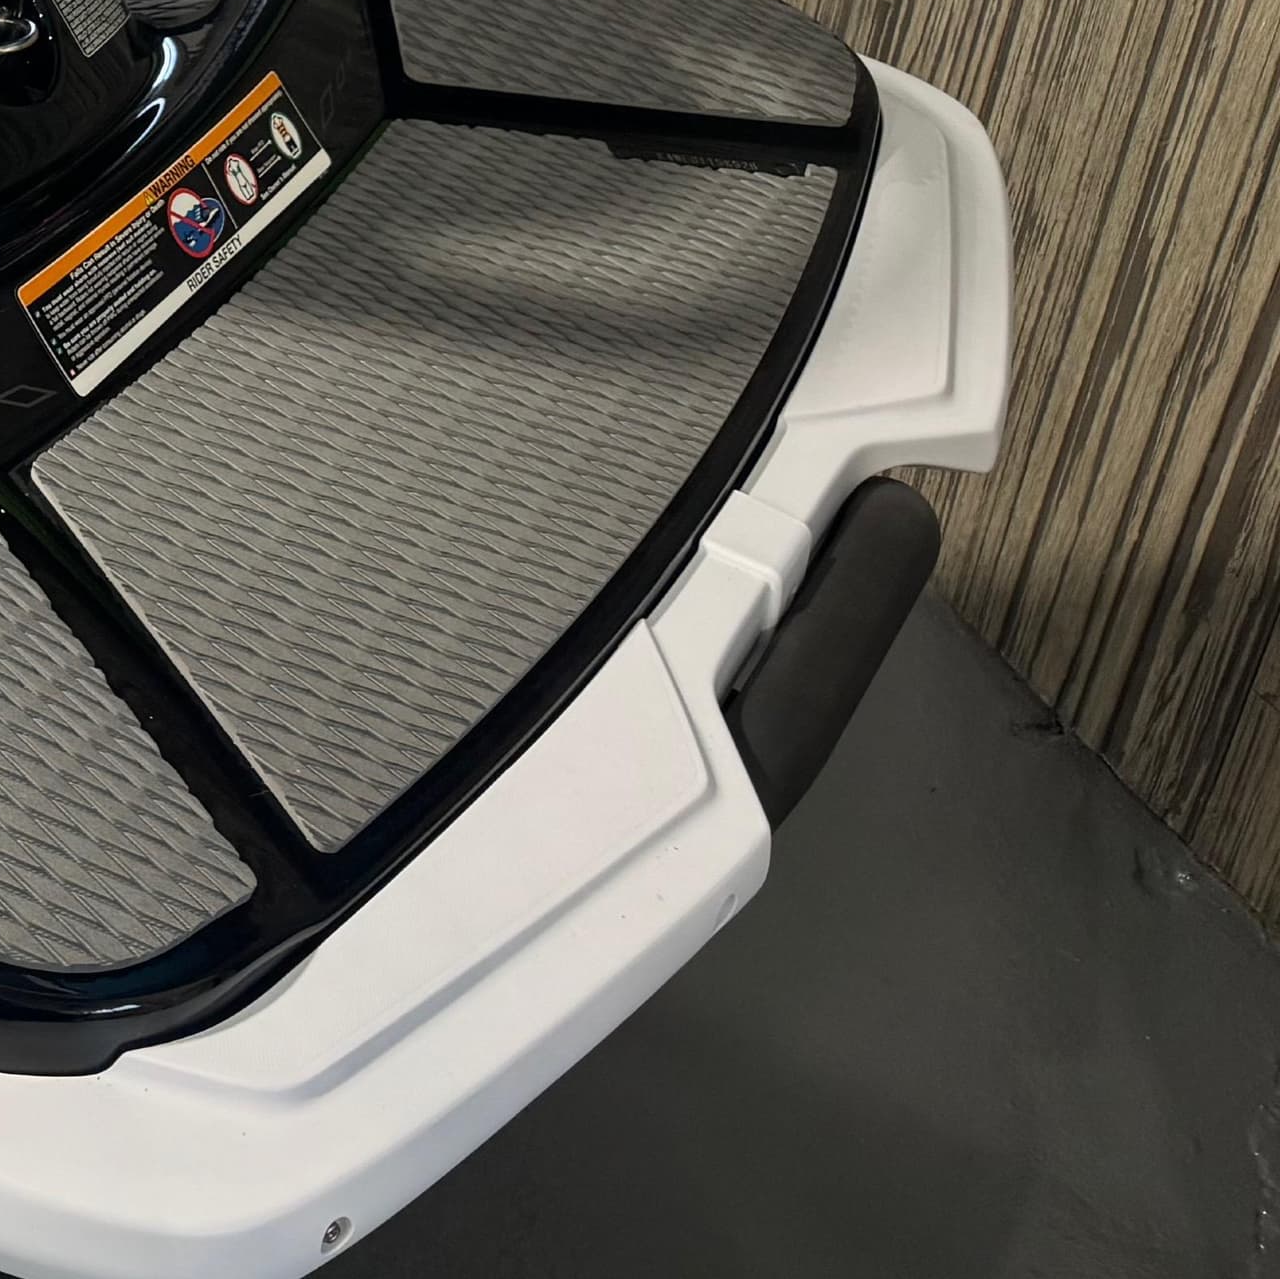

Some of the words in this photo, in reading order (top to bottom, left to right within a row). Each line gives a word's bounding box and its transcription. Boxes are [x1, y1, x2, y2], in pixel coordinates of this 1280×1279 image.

[149, 155, 194, 196] WARNING
[187, 262, 213, 290] RIDER
[212, 234, 241, 267] SAFETY
